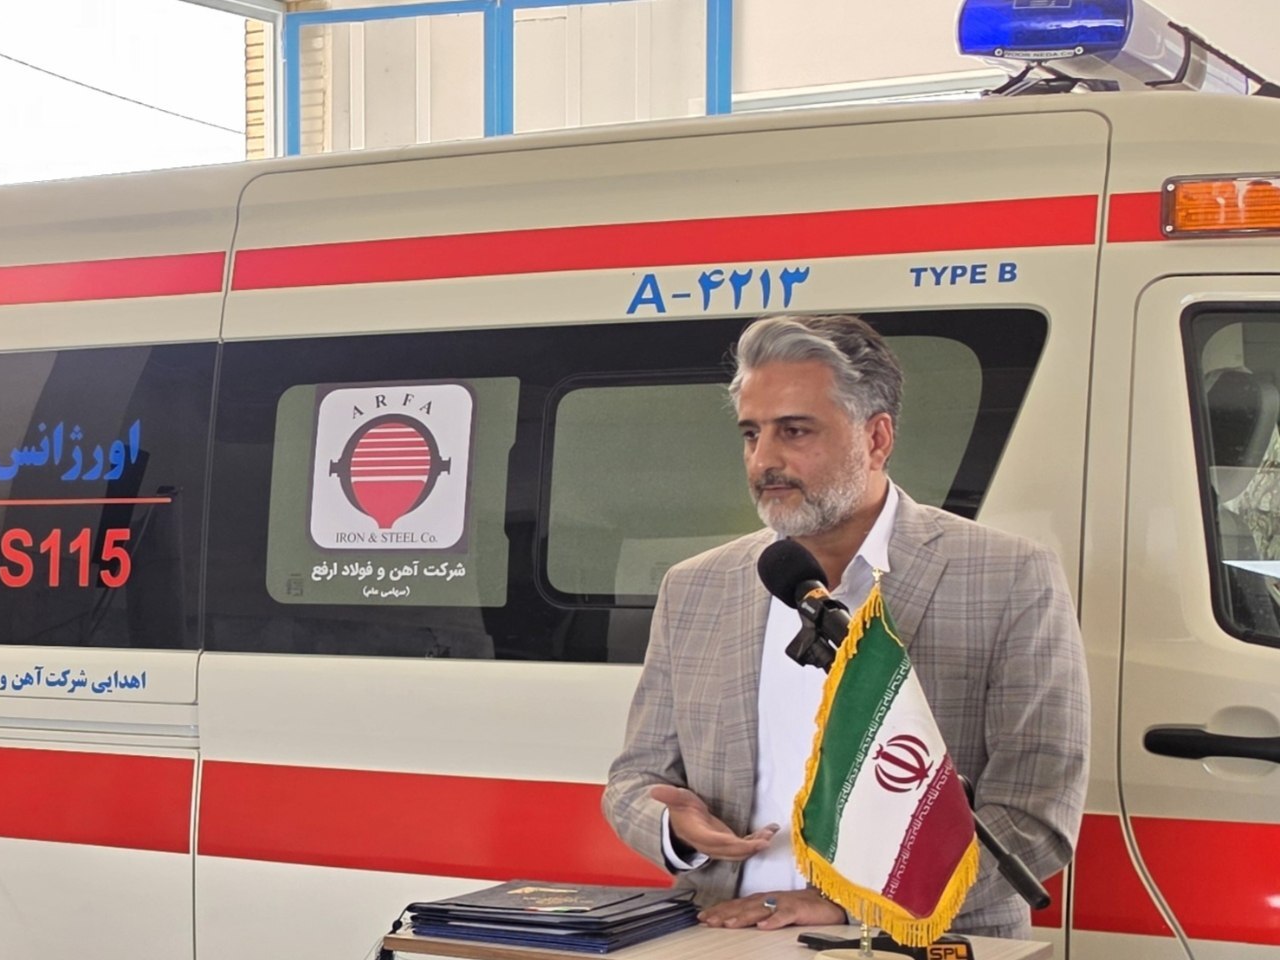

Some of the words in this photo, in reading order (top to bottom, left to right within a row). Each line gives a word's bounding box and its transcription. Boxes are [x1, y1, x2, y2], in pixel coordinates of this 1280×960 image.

[910, 264, 987, 287] TYPE
[998, 262, 1018, 283] B
[351, 393, 433, 419] ARFA
[335, 532, 365, 544] IRON
[368, 532, 378, 543] &
[381, 532, 419, 543] STEEL
[421, 532, 438, 543] Co.
[311, 561, 337, 581] ارفع
[341, 561, 373, 580] فولاد
[377, 567, 385, 580] و
[389, 560, 419, 581] آهن
[422, 562, 466, 582] شرکت
[0, 676, 7, 690] و
[11, 666, 44, 691] آهن
[45, 669, 88, 693] شرکت
[91, 670, 146, 693] اهدایی
